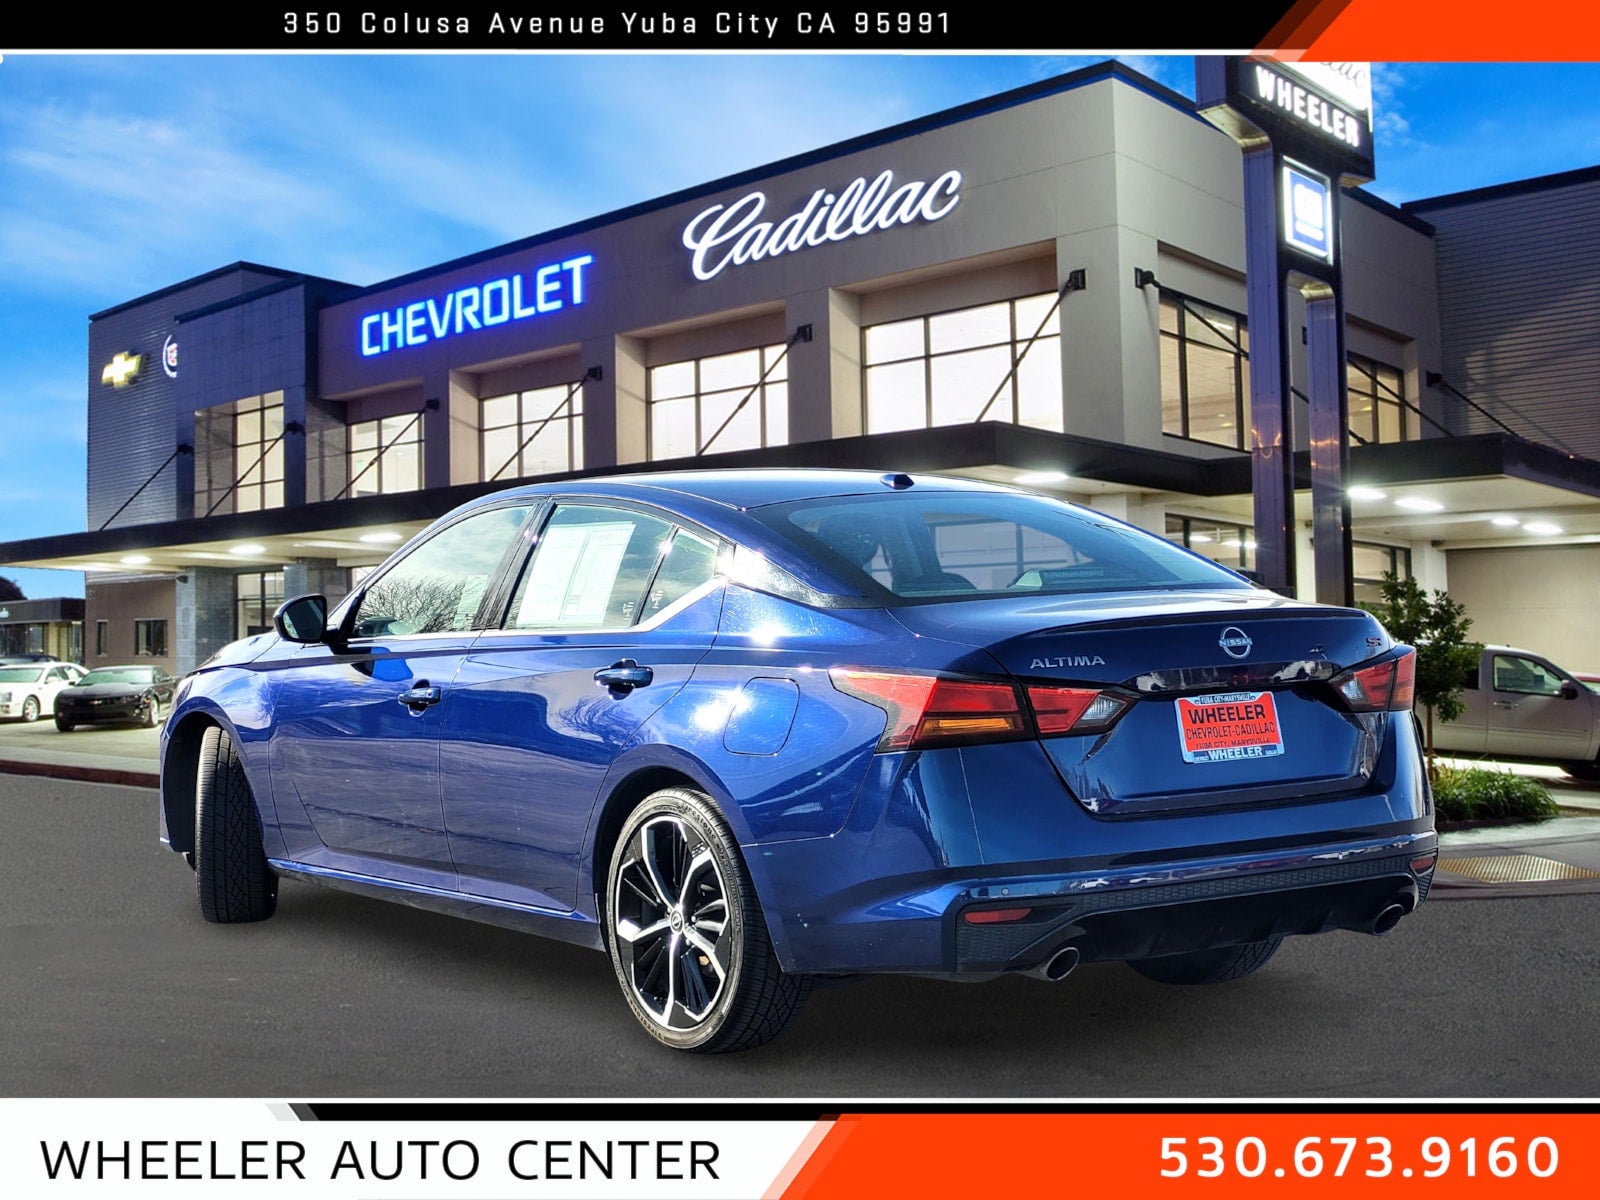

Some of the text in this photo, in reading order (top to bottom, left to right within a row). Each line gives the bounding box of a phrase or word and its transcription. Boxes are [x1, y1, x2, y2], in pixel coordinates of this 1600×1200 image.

[1255, 65, 1360, 147] WHEELER
[682, 169, 963, 281] Cadillac
[361, 255, 593, 357] CHEVROLET
[1030, 655, 1106, 669] ALTIMA
[1188, 704, 1266, 725] WHEELER
[1208, 746, 1263, 761] WHEELER
